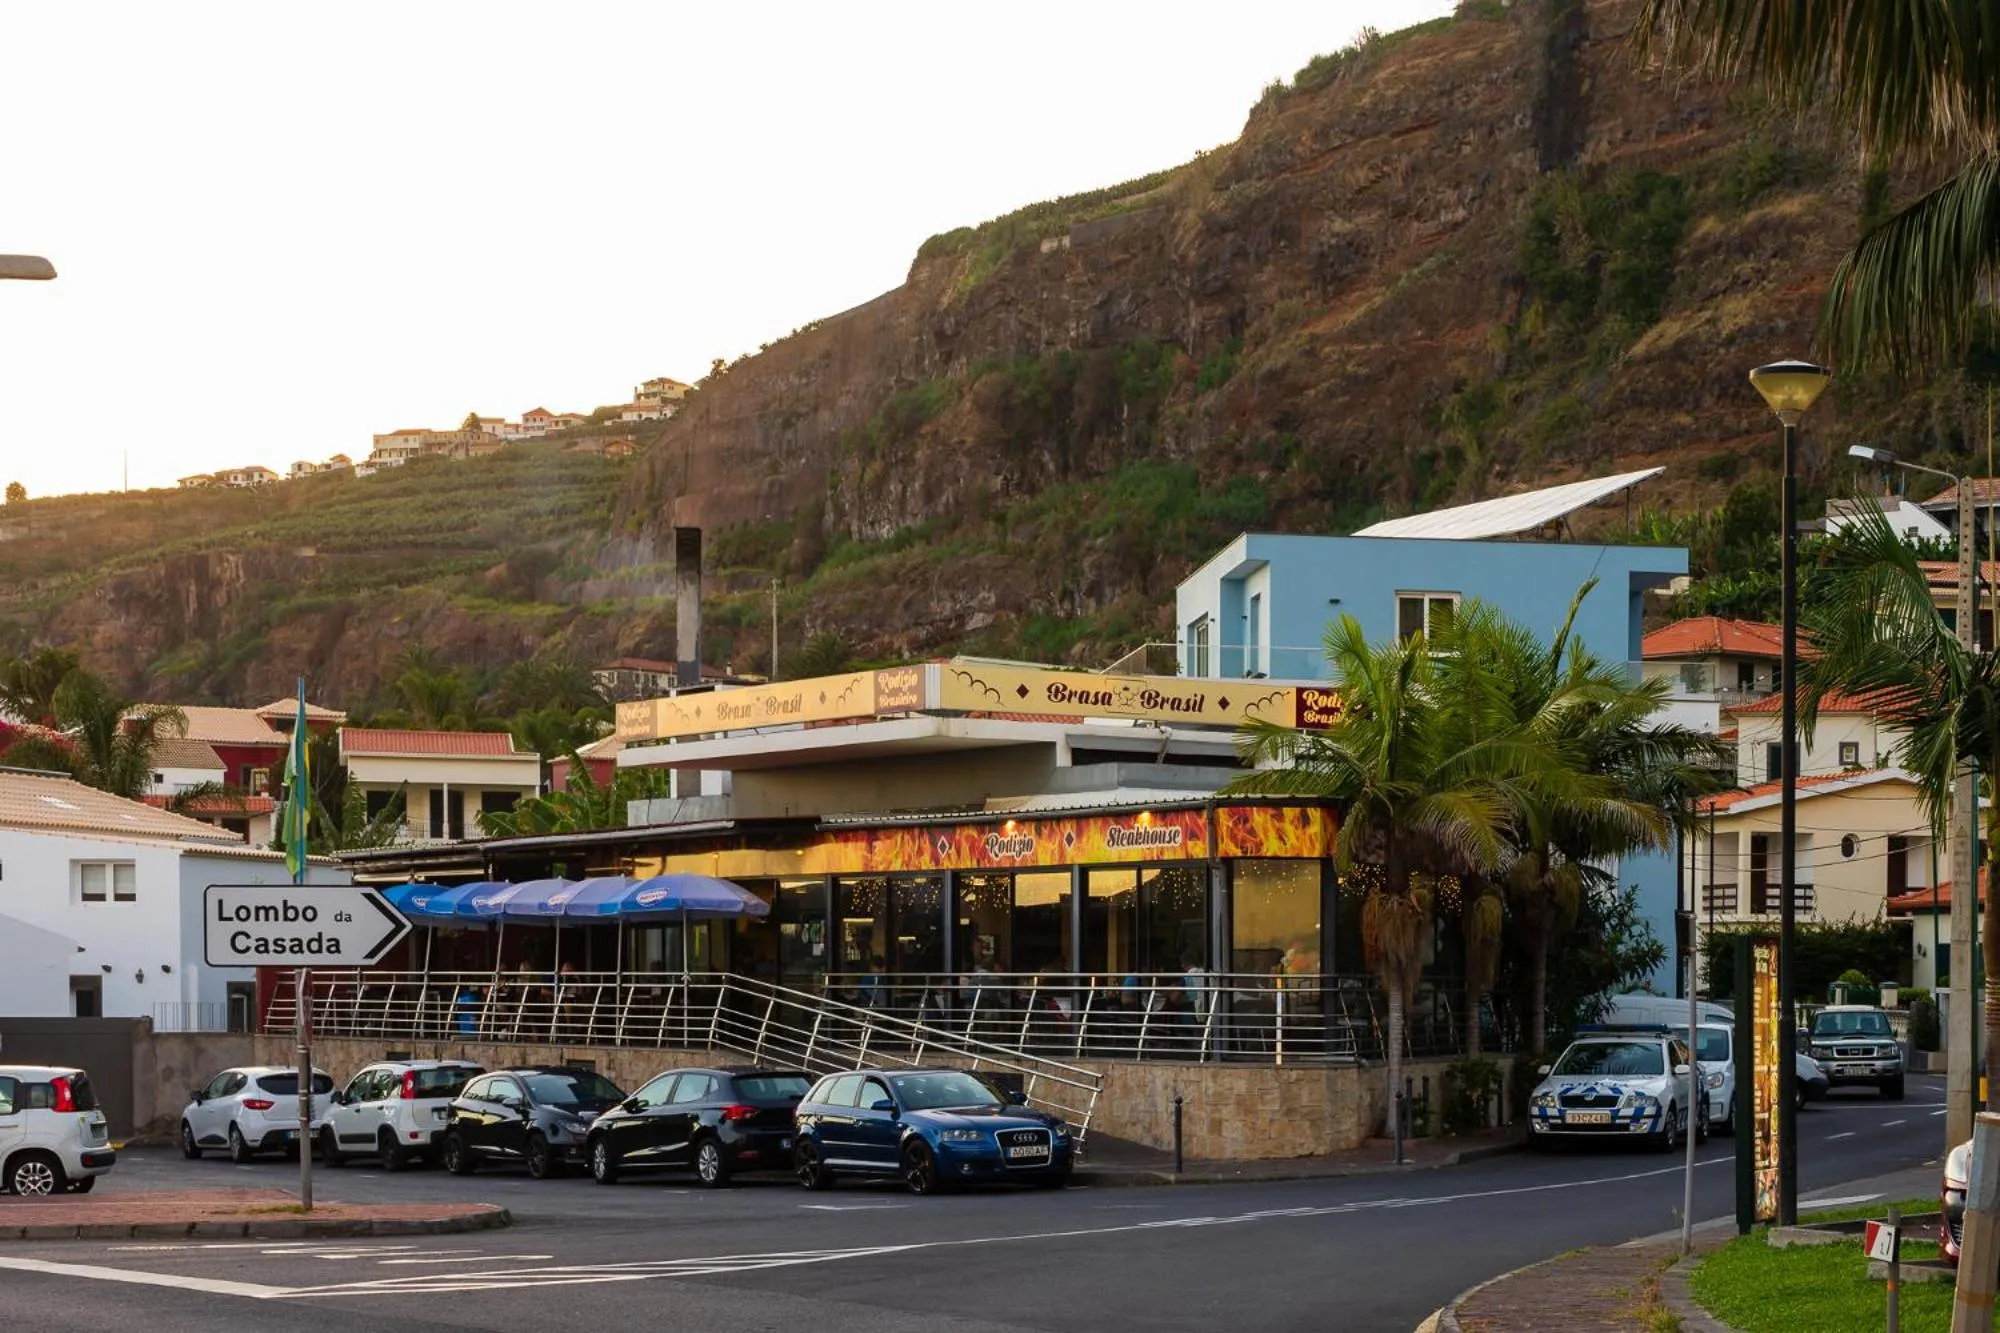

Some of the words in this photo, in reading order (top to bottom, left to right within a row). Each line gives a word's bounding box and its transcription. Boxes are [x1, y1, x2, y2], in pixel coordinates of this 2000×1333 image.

[717, 701, 752, 720] Brasa
[766, 692, 802, 716] Brasil
[1046, 681, 1113, 706] Brasa
[1140, 689, 1205, 712] Brasil
[986, 833, 1035, 859] Rodizio
[1106, 825, 1181, 848] Steakhouse
[217, 899, 318, 922] Lombo
[334, 910, 352, 922] da
[230, 931, 342, 954] Casada
